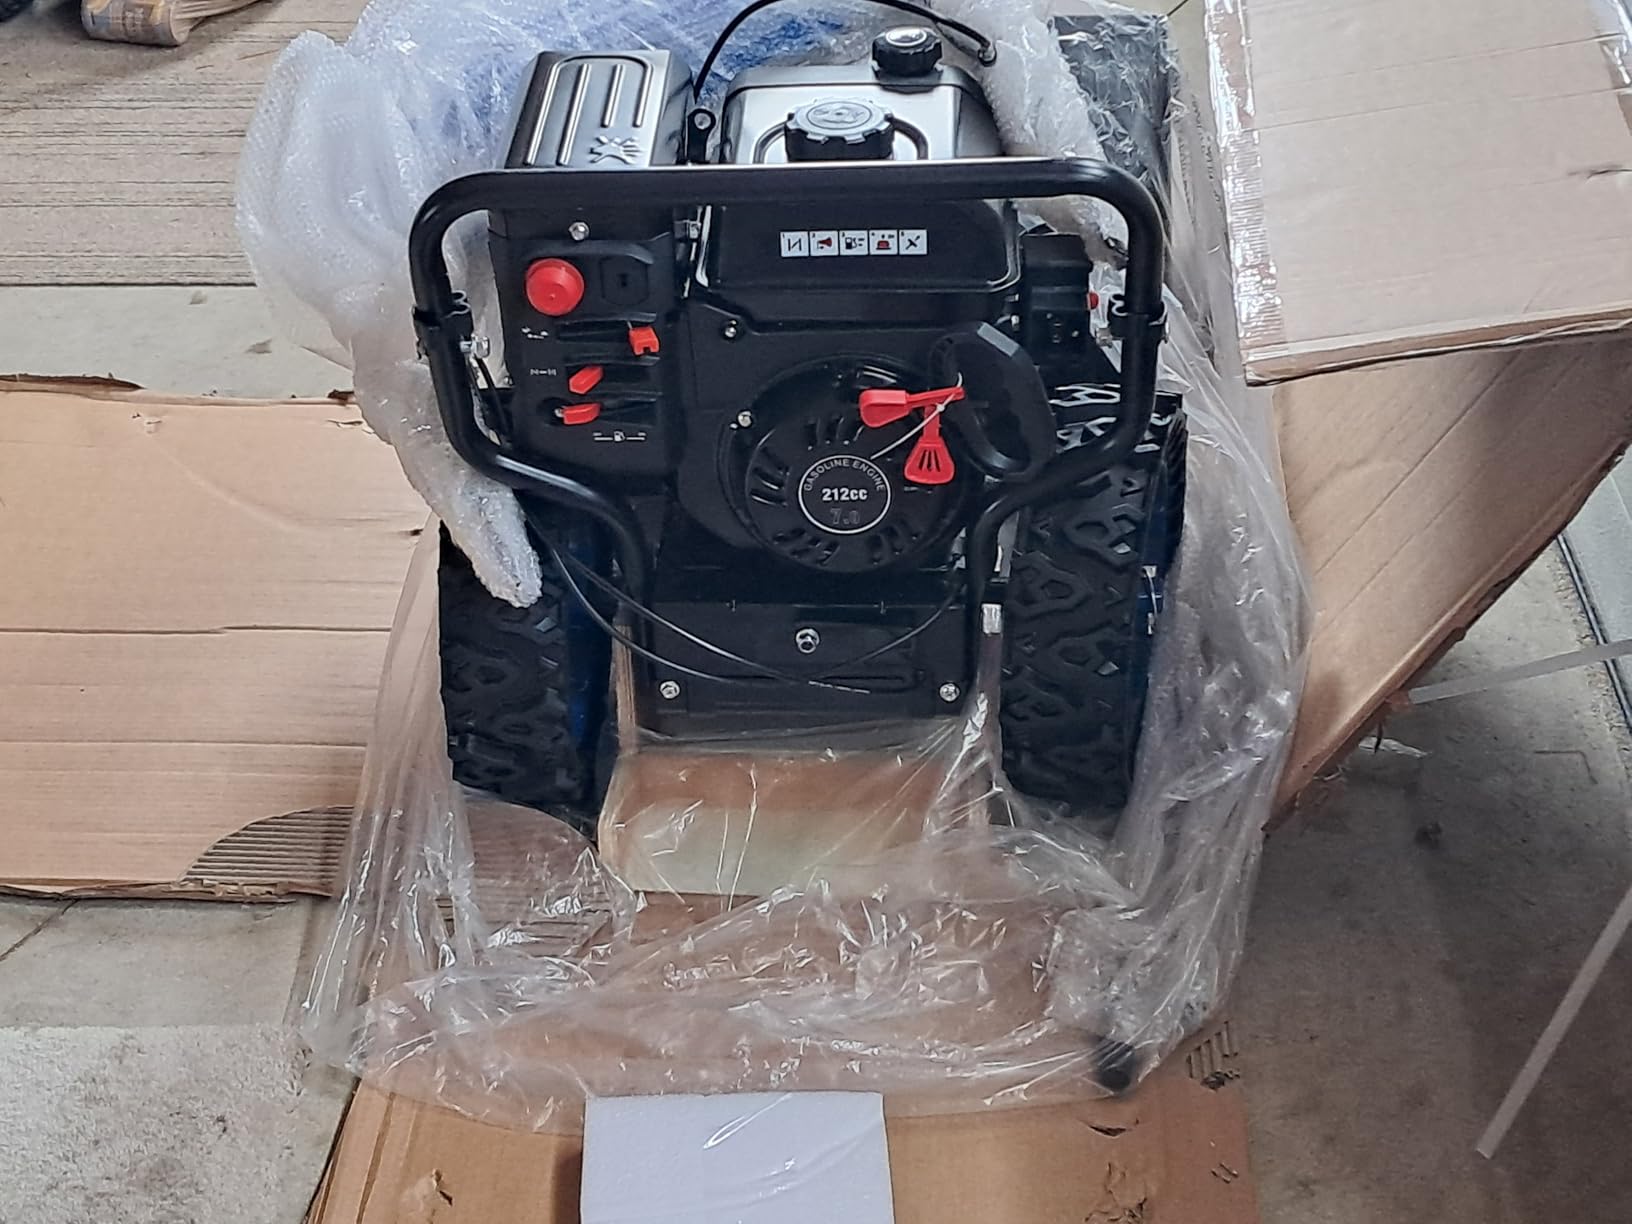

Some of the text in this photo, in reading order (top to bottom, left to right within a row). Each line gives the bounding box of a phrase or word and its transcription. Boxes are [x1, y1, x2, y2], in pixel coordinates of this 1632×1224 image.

[803, 458, 886, 491] GASOLINE ENGINE
[821, 487, 868, 501] 212cc
